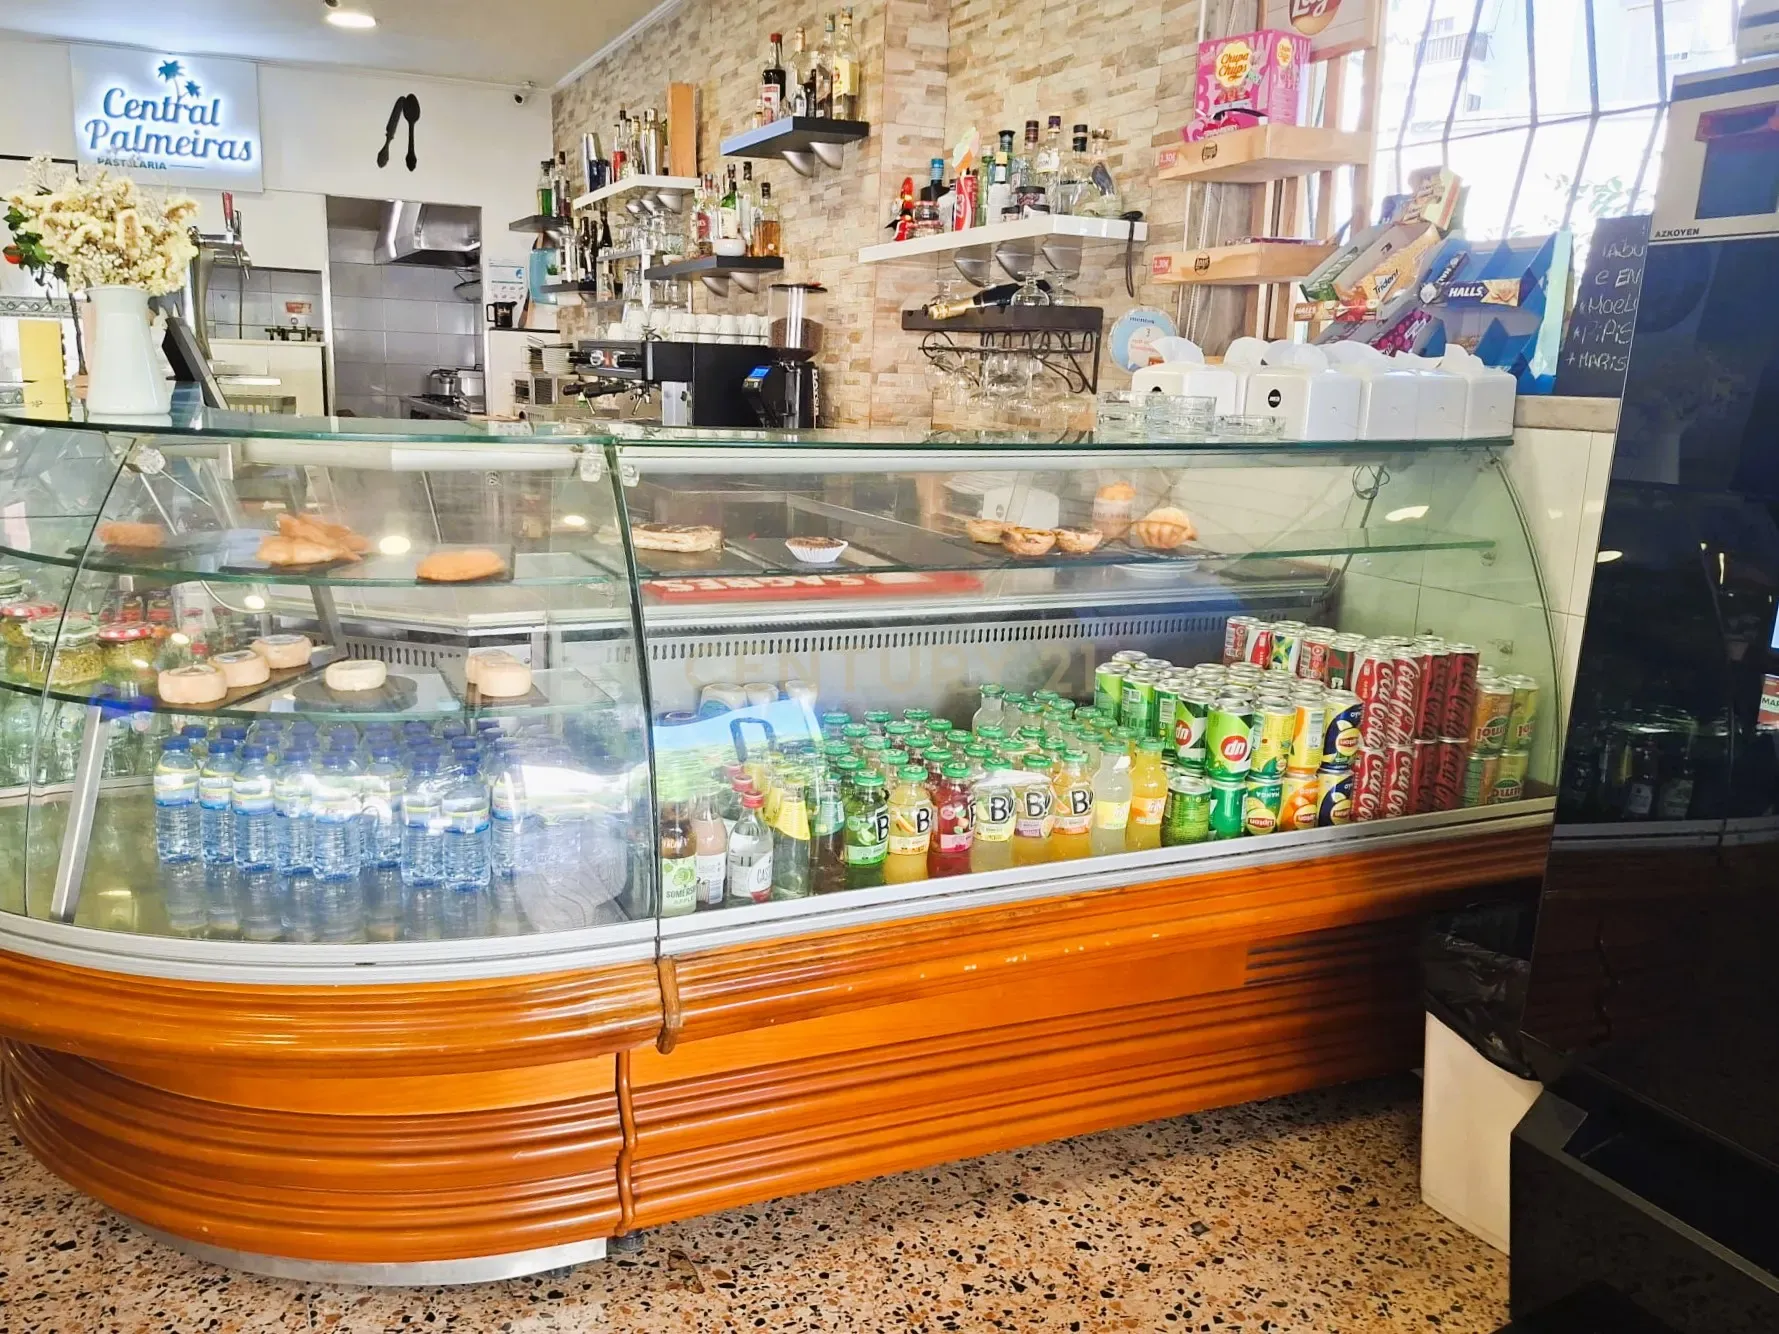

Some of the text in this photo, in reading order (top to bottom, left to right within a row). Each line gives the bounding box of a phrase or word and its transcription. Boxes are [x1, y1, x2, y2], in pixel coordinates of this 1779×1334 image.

[1221, 52, 1249, 65] Chupa
[1218, 63, 1248, 80] Chups
[103, 87, 221, 126] Central
[84, 118, 252, 161] Palmeiras
[1655, 228, 1700, 237] AZKOYEN
[1373, 268, 1400, 295] Trident
[1448, 286, 1484, 298] HALLS
[1255, 791, 1280, 799] MANGA
[1248, 817, 1274, 828] Lipton
